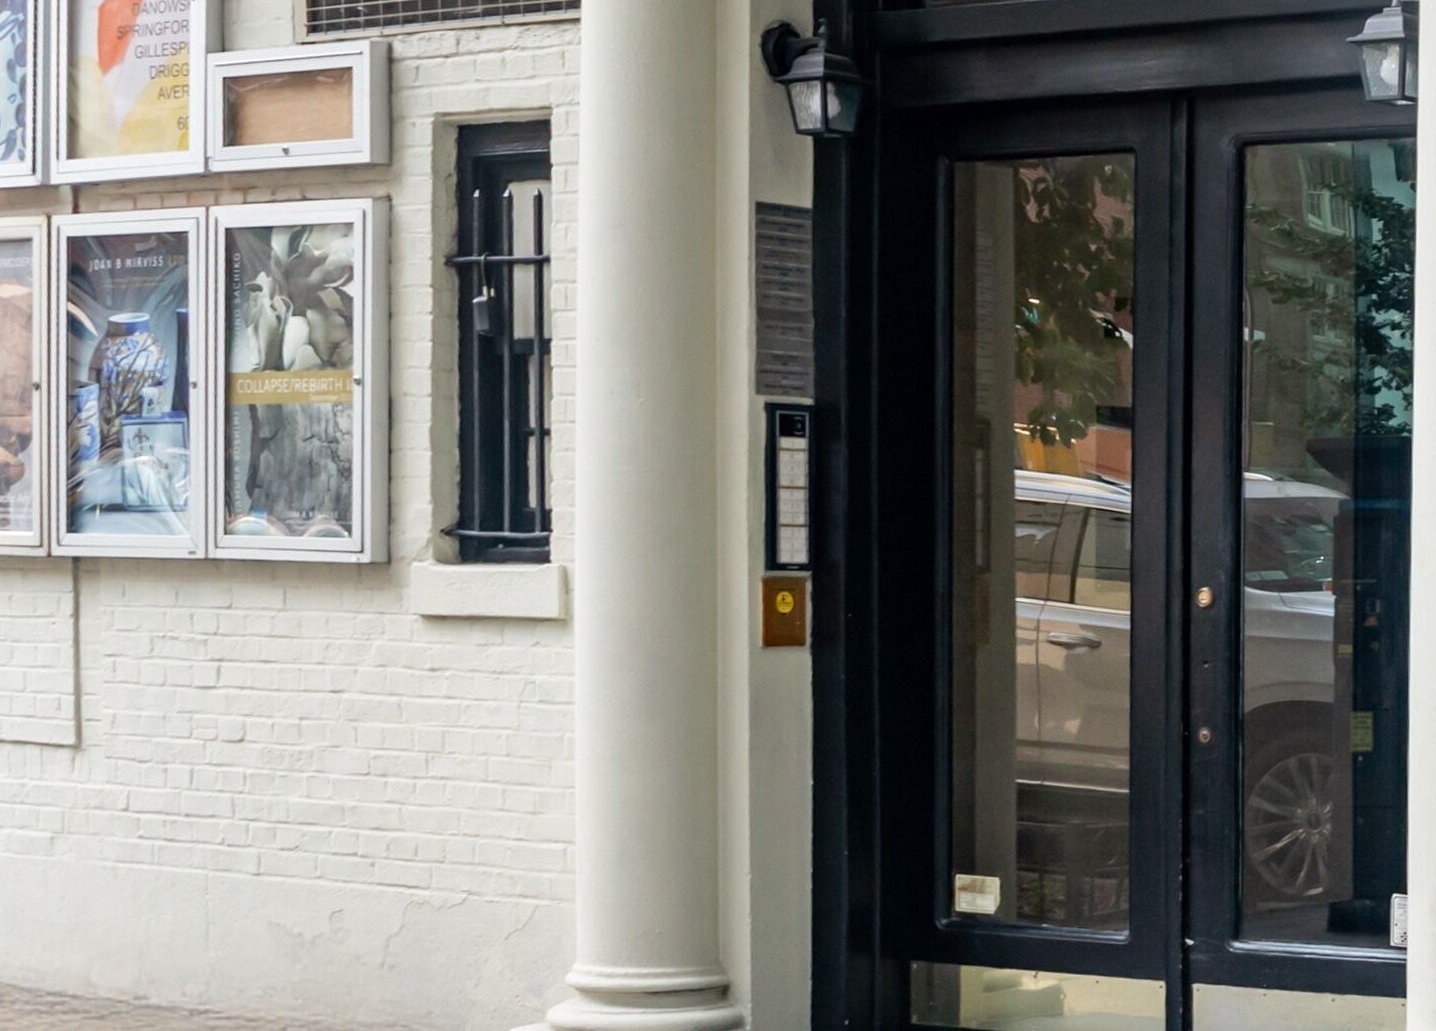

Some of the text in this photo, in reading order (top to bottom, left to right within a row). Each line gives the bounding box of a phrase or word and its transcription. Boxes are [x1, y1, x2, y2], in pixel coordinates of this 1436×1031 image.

[117, 19, 190, 40] SPRINGFOR
[88, 258, 112, 273] JOAN
[124, 255, 164, 268] MIRVISS
[237, 377, 343, 394] COLLAPSE/REBIRTH
